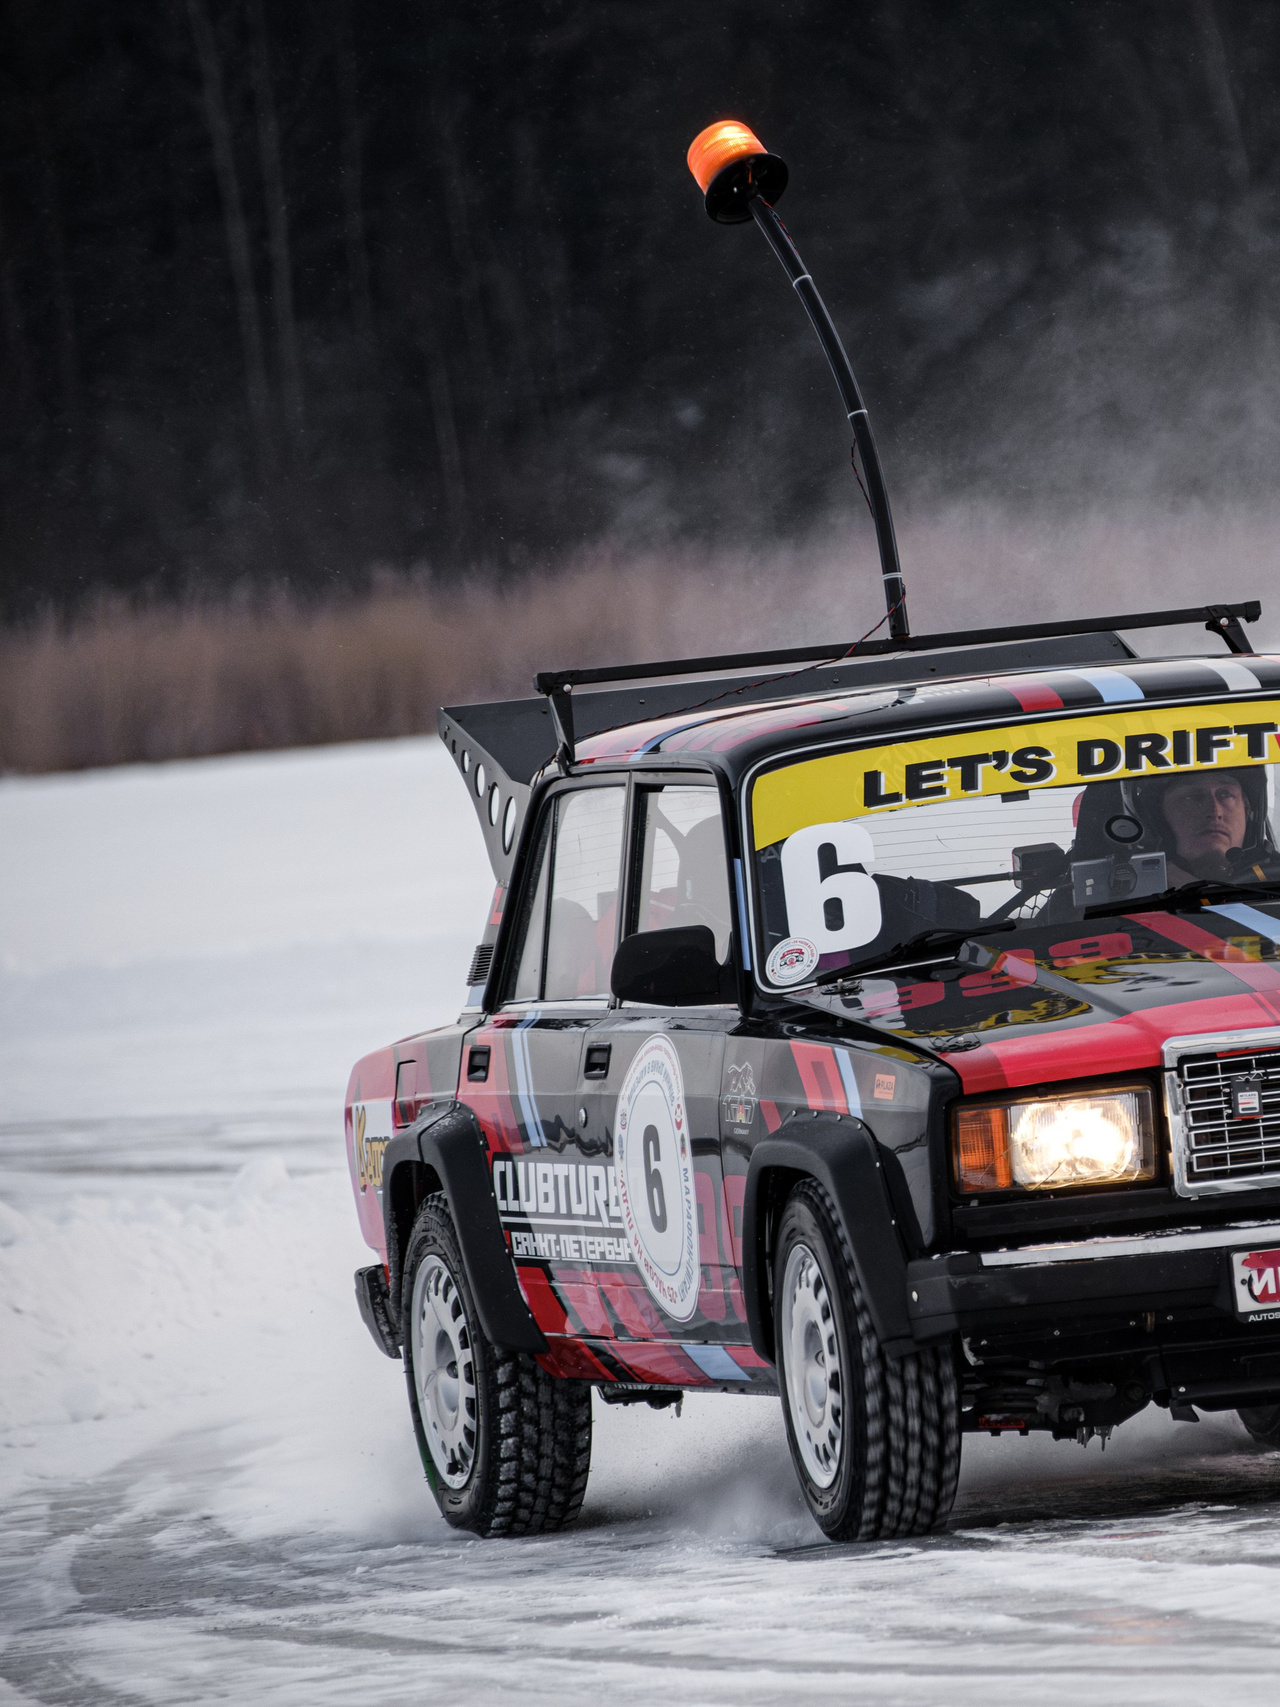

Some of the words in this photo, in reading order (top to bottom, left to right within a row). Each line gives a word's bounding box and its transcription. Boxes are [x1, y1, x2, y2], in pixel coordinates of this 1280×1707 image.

[864, 746, 1056, 809] LET'S
[1077, 722, 1280, 777] DRIFT
[780, 821, 882, 954] 6
[642, 1124, 667, 1233] 6
